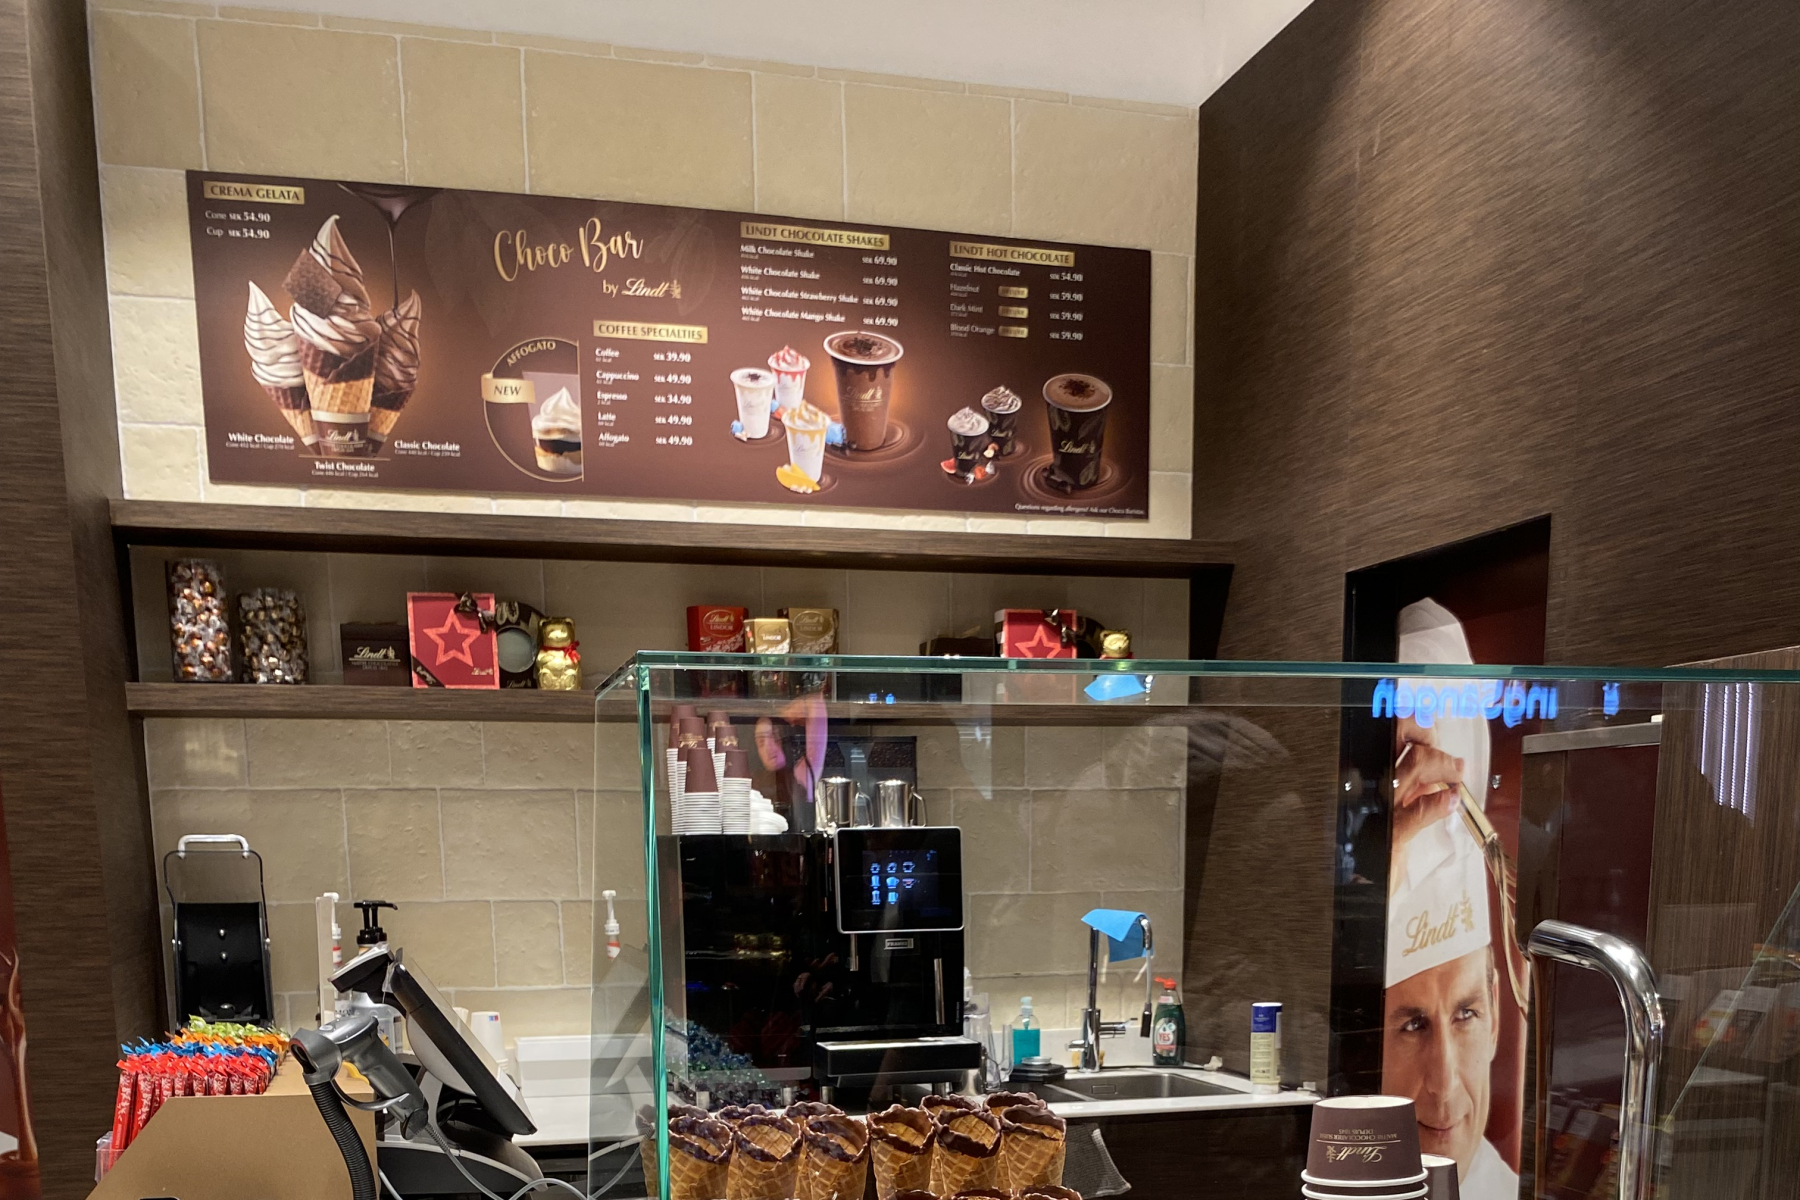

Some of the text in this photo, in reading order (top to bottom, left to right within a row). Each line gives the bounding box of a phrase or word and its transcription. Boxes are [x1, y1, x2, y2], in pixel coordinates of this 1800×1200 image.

[211, 185, 299, 200] CREMA GELATA
[205, 210, 226, 220] Cone
[244, 212, 270, 222] 54.90
[206, 226, 223, 237] Cup
[242, 228, 270, 239] 54.90
[746, 226, 885, 247] LINDT CHOCOLATE SHAKES
[494, 218, 643, 282] Choco Bar
[741, 244, 814, 258] Milk Chocolate Shake
[954, 245, 1070, 263] LINDT HOT CHOCOLATE
[874, 256, 897, 266] 69.90
[741, 266, 762, 275] White
[764, 267, 798, 278] Chocolate
[800, 270, 820, 280] Shake
[950, 264, 1020, 276] Classic Hot Chocolate
[875, 276, 898, 286] 69.90
[1060, 273, 1083, 282] 54.90
[602, 278, 670, 298] by Lindt
[950, 284, 980, 293] Hazelnut
[741, 286, 762, 296] White
[764, 288, 799, 299] Chocolate
[800, 292, 837, 304] Strawberry
[838, 294, 858, 304] Shake
[875, 297, 898, 307] 69.90
[950, 304, 983, 313] Dark Mint
[741, 307, 846, 322] White Chocolate Mango Shake
[875, 318, 898, 327] 69.90
[598, 325, 702, 340] COFFEE SPECIALTIES
[950, 324, 970, 332] Blood
[971, 325, 995, 335] Orange
[506, 341, 556, 367] AFFOGATO
[595, 348, 620, 357] Coffee
[666, 352, 691, 362] 39.90
[596, 370, 640, 382] Cappuccino
[666, 374, 692, 384] 49.90
[494, 386, 521, 396] NEW
[597, 391, 628, 401] Espresso
[667, 394, 692, 404] 34.90
[598, 412, 616, 420] Latte
[667, 415, 692, 425] 49.90
[228, 433, 294, 444] White Chocolate
[599, 432, 630, 443] Affogato
[668, 436, 693, 446] 49.90
[395, 440, 460, 451] Classic Chocolate
[314, 461, 375, 472] Twist Chocolate
[354, 646, 387, 659] Lindt
[1402, 902, 1459, 957] Lindt
[1158, 1033, 1170, 1041] YES
[1335, 1146, 1387, 1162] Lindt
